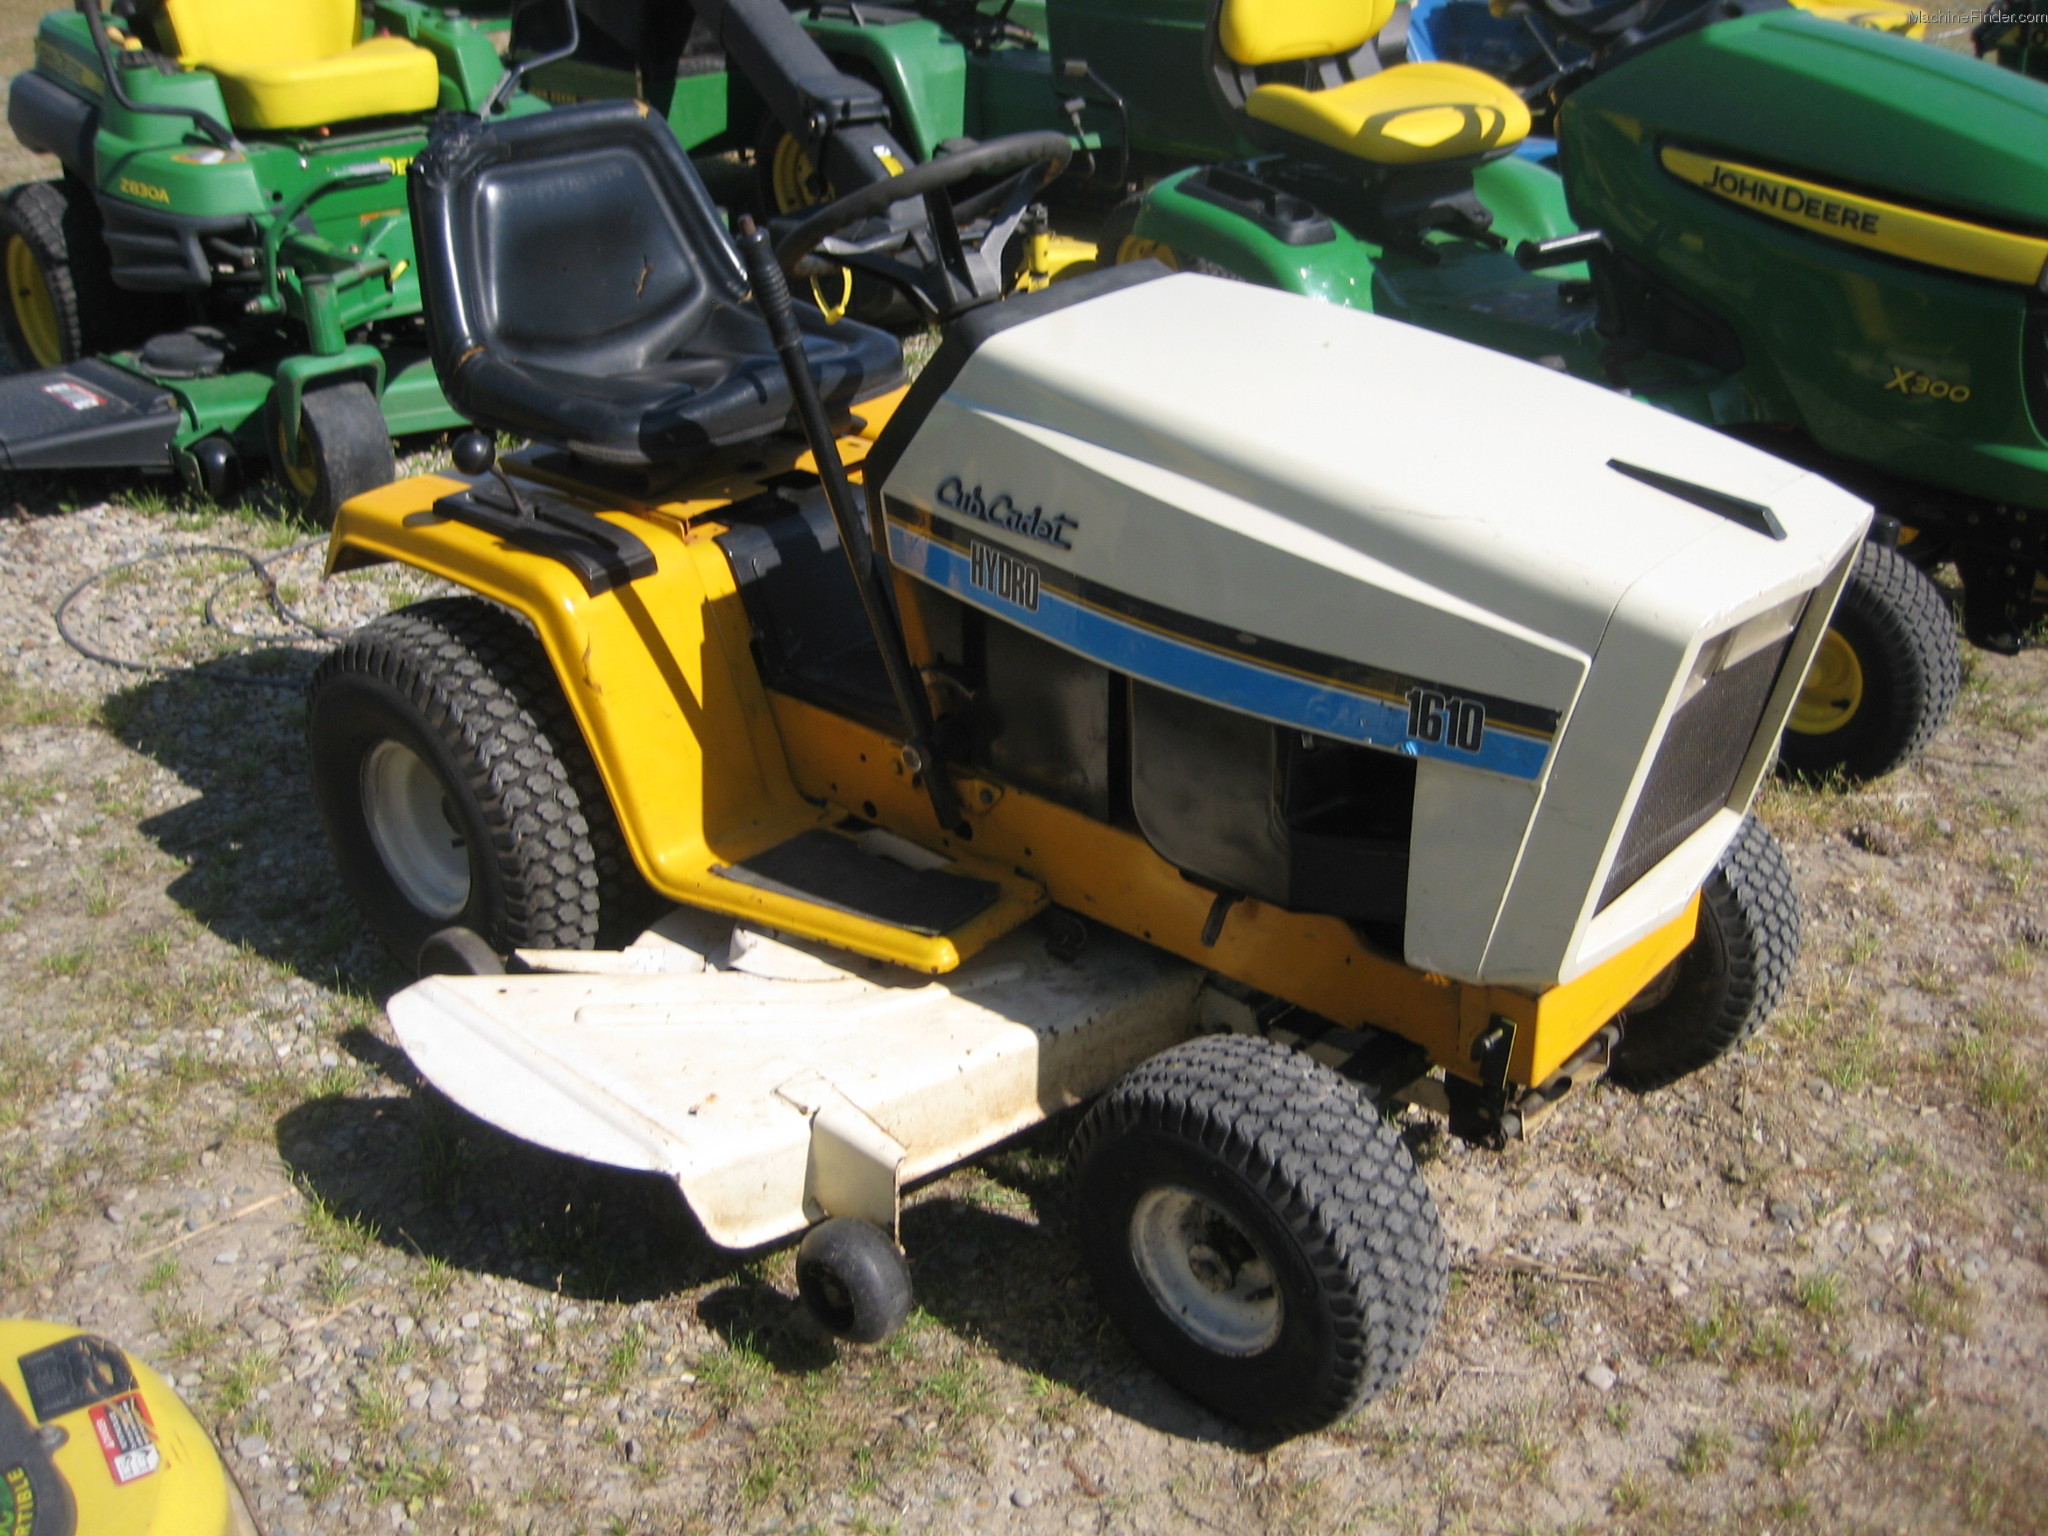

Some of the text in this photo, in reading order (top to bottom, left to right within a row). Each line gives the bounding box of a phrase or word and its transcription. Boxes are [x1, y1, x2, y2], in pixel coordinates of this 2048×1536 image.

[1703, 165, 1880, 235] JOHN DEERE
[1883, 365, 1971, 402] X300
[936, 476, 1079, 550] Cub Cadet
[970, 540, 1041, 613] HYDRO
[1405, 686, 1486, 755] 1610
